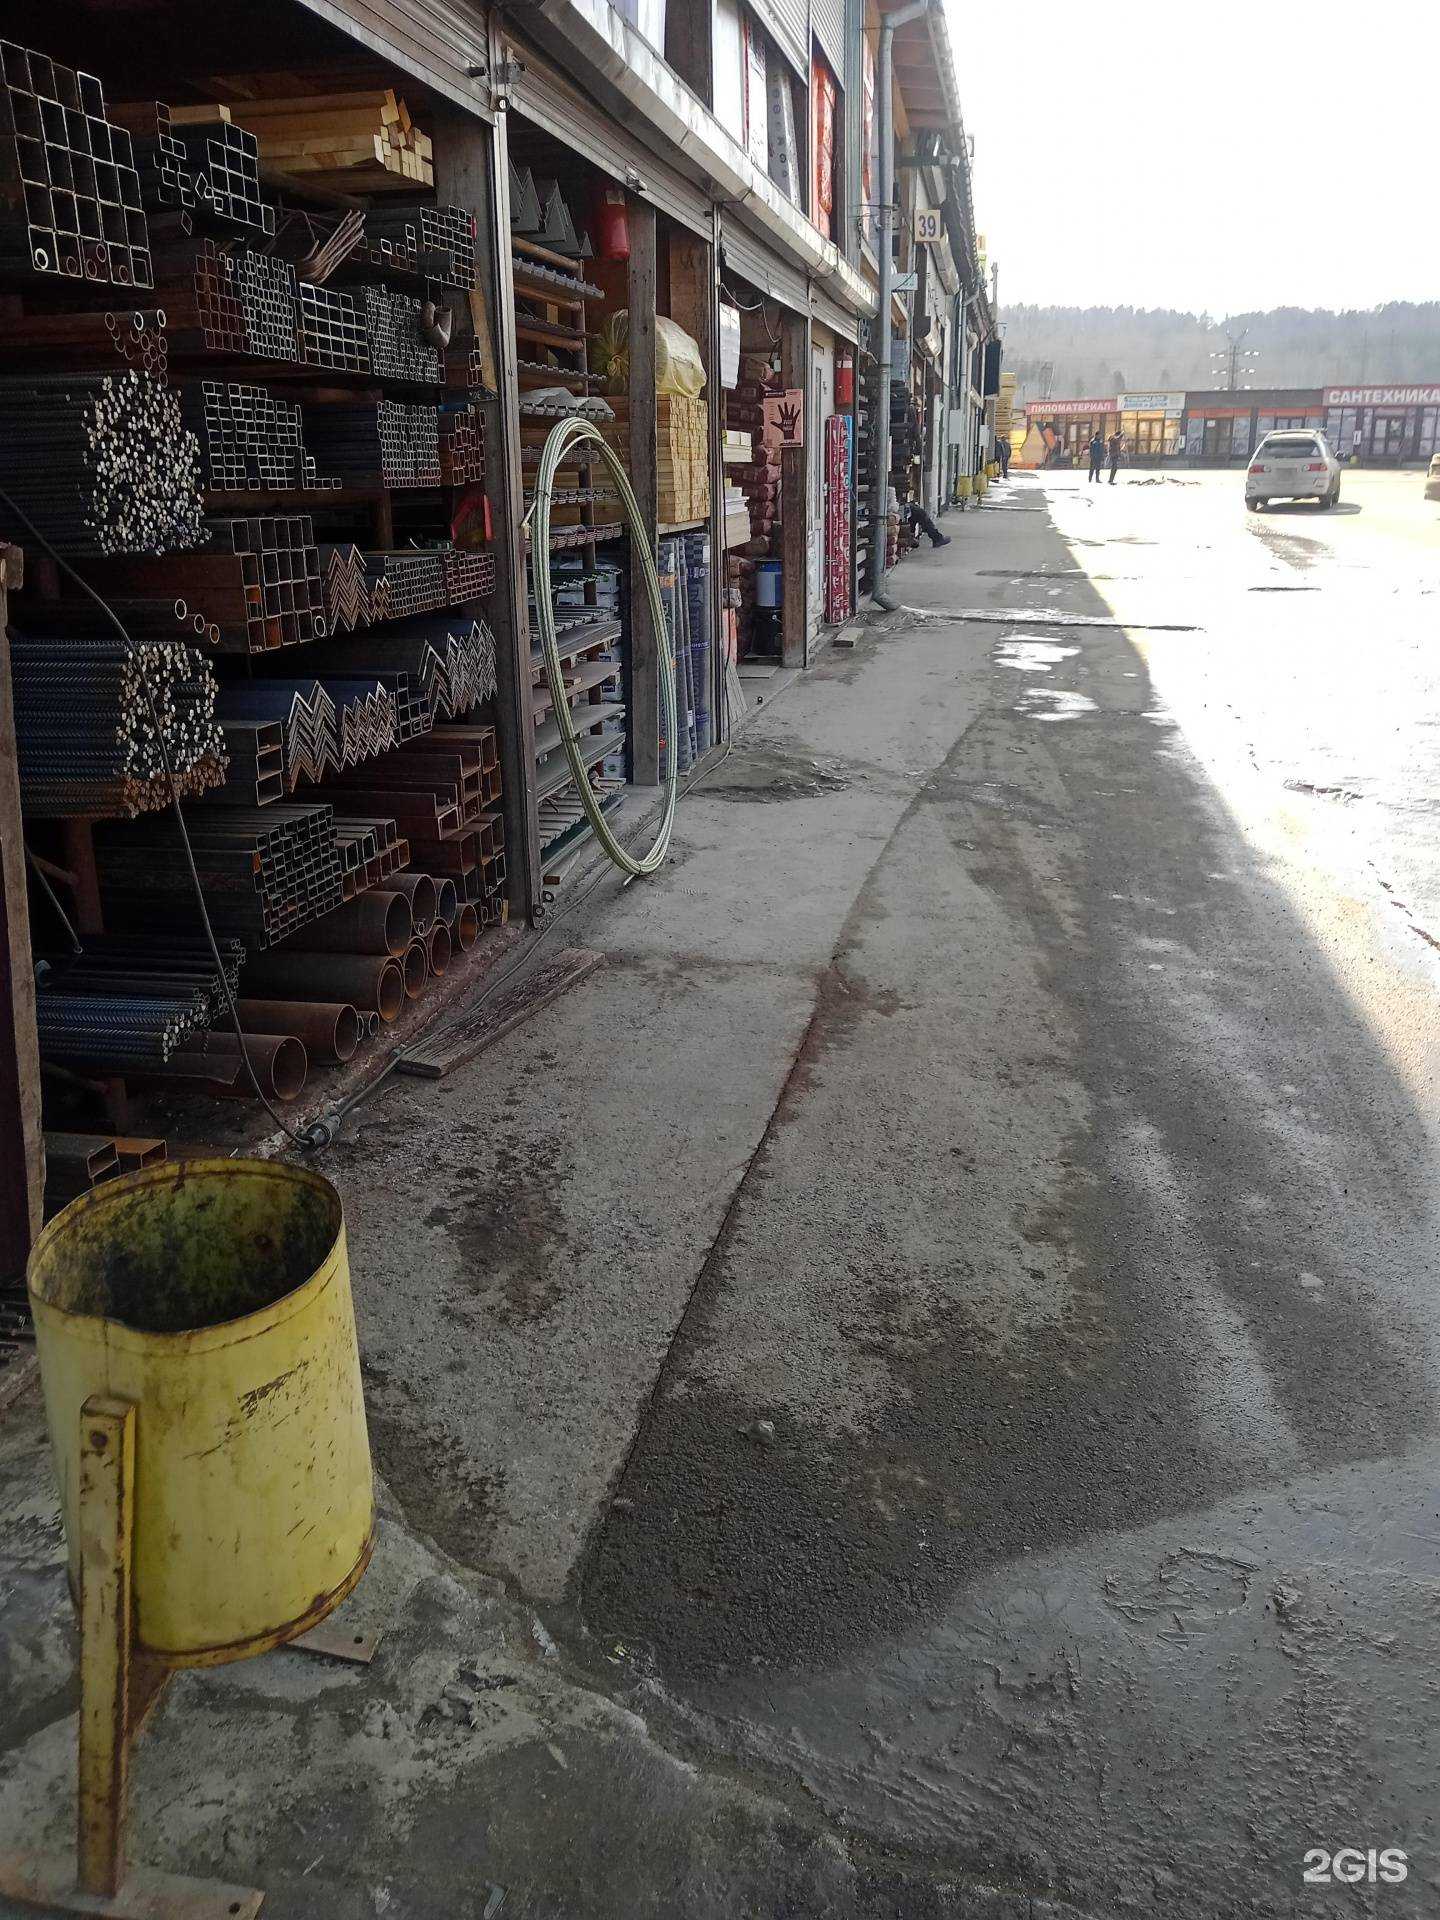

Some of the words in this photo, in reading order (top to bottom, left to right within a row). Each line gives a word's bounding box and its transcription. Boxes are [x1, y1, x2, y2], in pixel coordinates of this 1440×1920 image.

[918, 214, 936, 238] 39
[1328, 388, 1440, 404] САНТЕХНИКА
[1030, 401, 1112, 413] ПИЛОМАТЕРИАЛ
